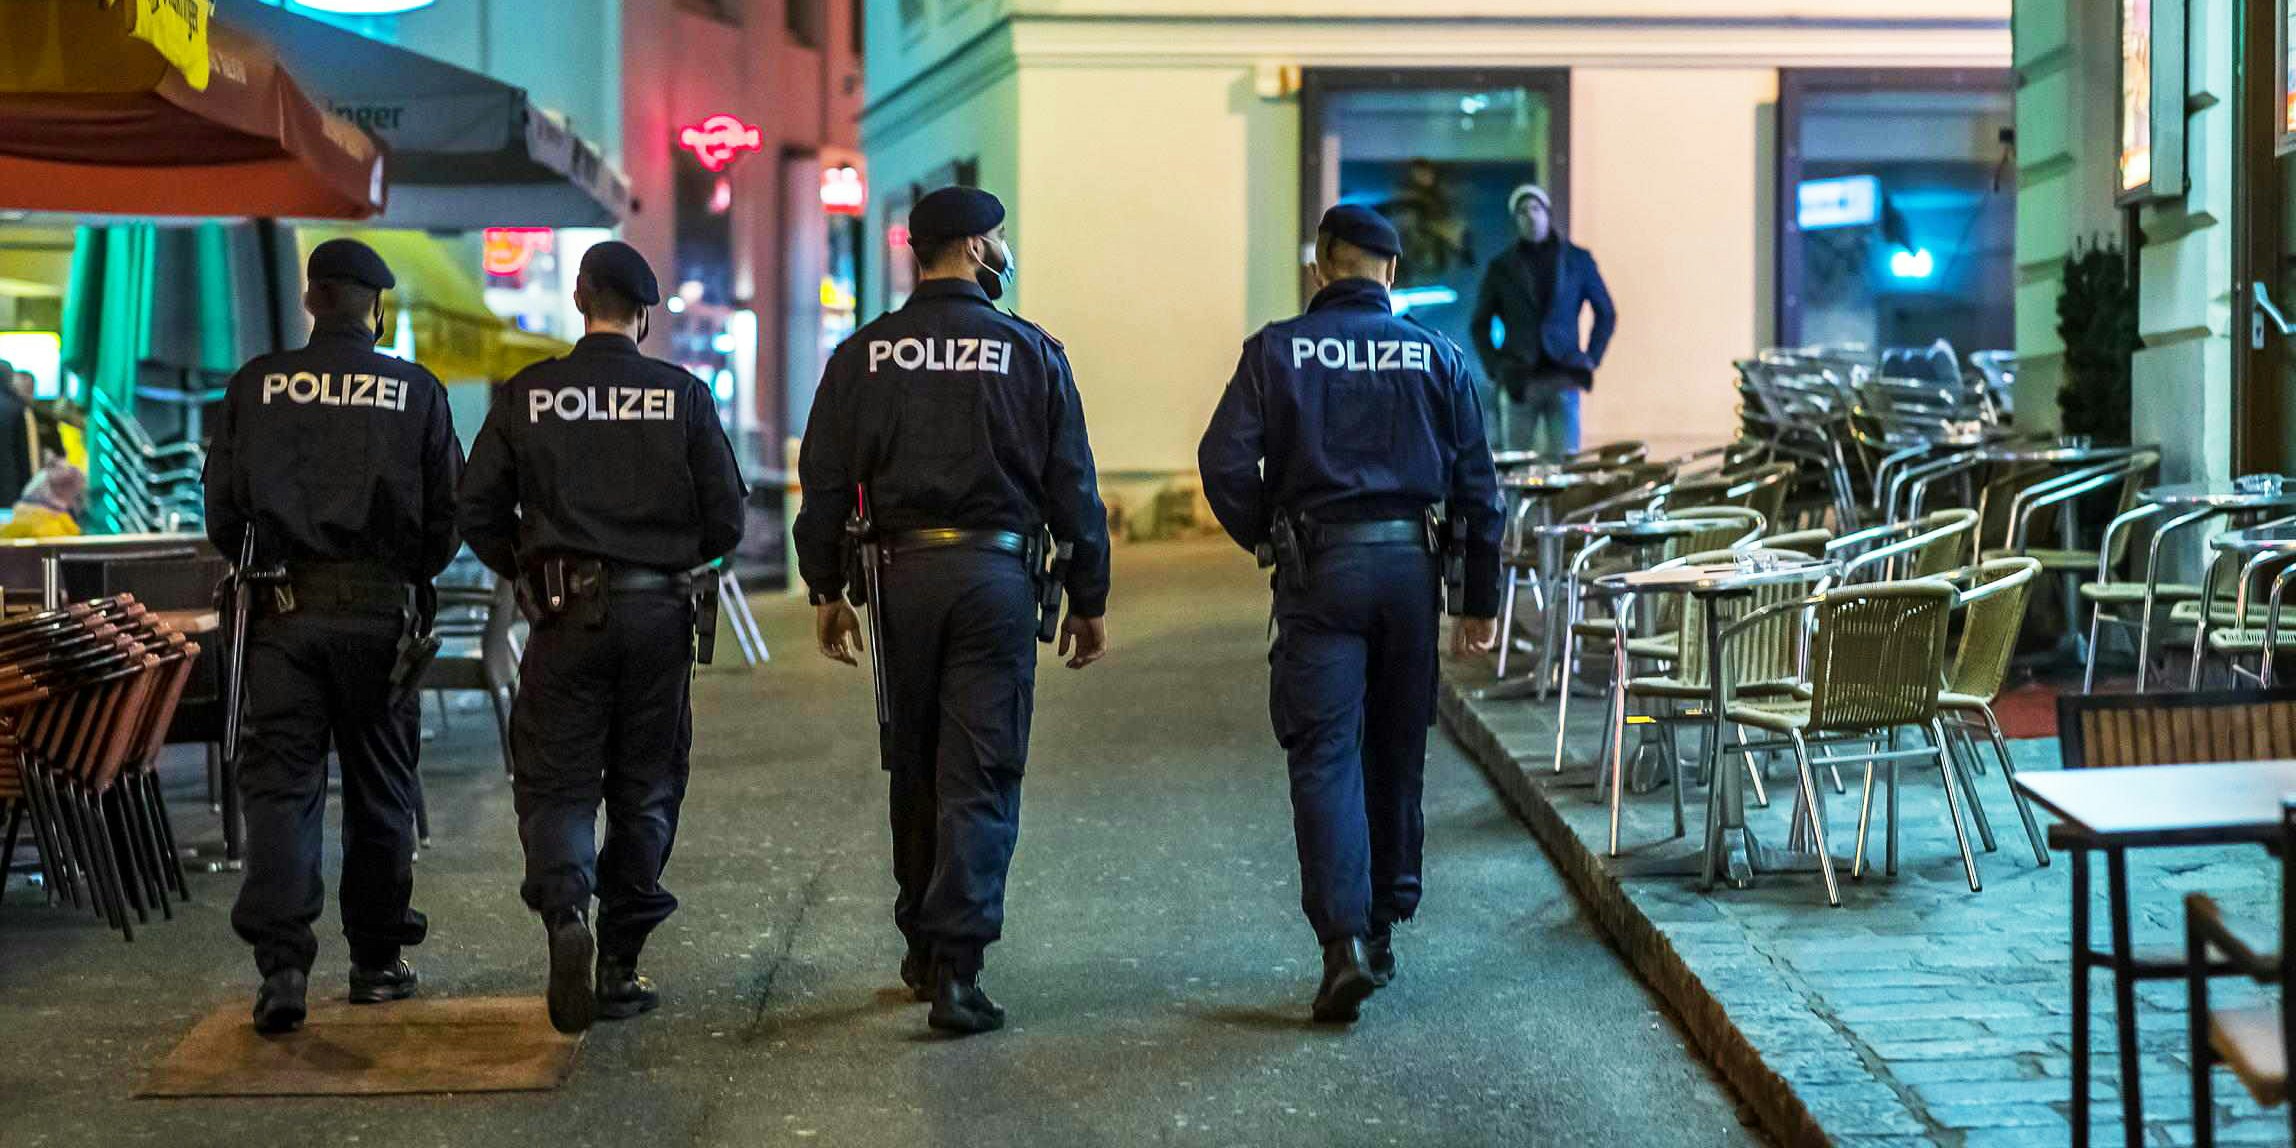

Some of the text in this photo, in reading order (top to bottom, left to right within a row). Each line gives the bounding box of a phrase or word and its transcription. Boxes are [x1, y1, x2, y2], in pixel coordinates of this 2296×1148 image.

[869, 338, 1012, 375] POLIZEI
[1291, 337, 1431, 373] POLIZEI
[263, 371, 409, 412] POLIZEI
[529, 386, 675, 423] POLIZEI
